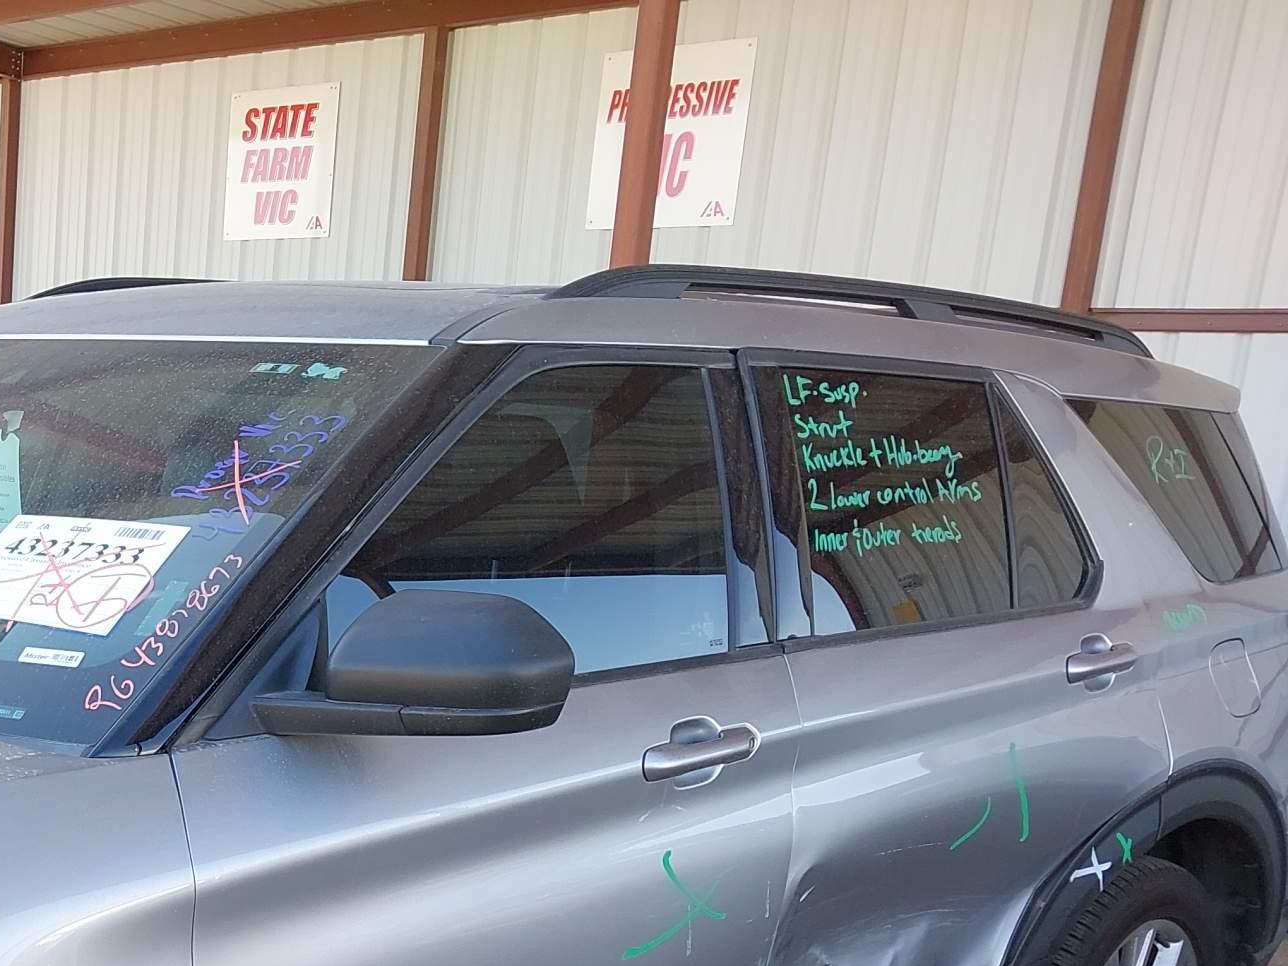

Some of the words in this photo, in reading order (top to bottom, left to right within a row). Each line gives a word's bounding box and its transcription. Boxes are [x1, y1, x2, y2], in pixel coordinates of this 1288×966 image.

[606, 78, 740, 124] PRESSIVE
[242, 102, 320, 143] STATE
[240, 145, 314, 183] FARM
[253, 189, 299, 225] VIC
[795, 410, 853, 439] Strut
[802, 440, 867, 472] Knuckle
[807, 478, 829, 511] 2
[5, 536, 145, 565] 43237333
[814, 528, 849, 553] Inner
[120, 554, 243, 667] 43878673
